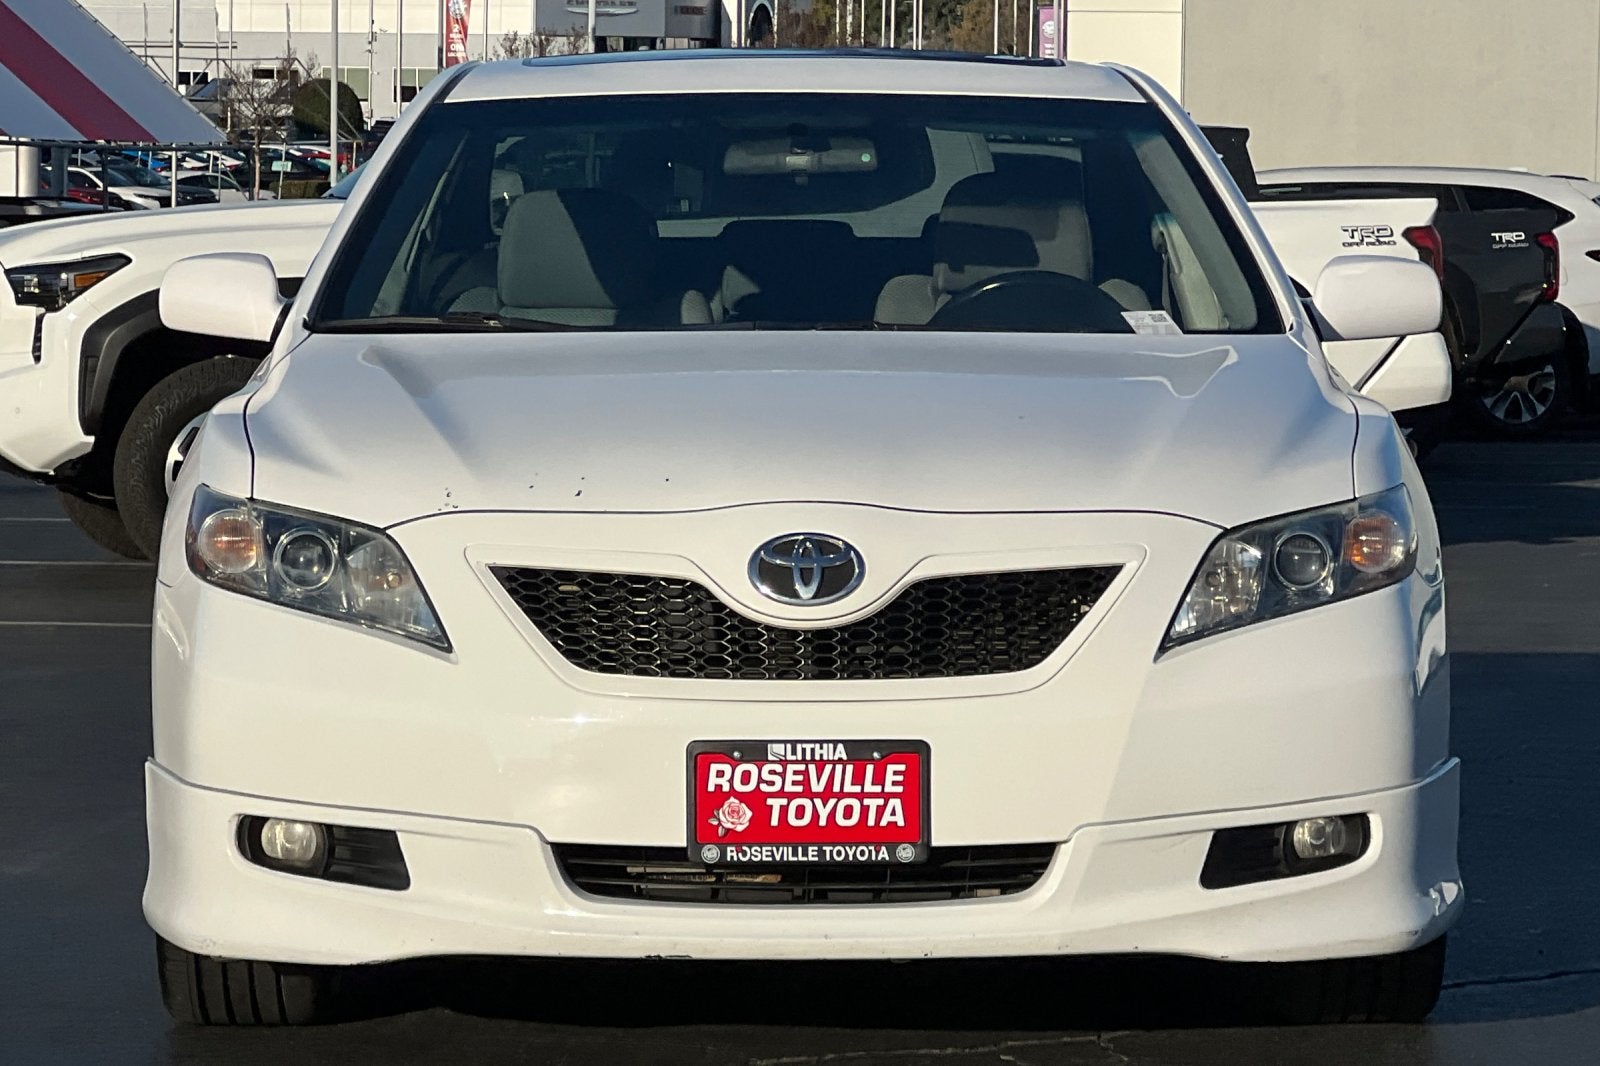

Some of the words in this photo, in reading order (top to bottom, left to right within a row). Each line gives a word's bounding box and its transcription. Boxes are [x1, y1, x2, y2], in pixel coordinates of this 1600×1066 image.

[1341, 225, 1394, 242] TRD
[1491, 231, 1525, 243] TRD
[785, 743, 847, 760] LITHIA
[707, 763, 906, 792] ROSEVILLE
[766, 798, 905, 827] TOYOTA
[726, 846, 818, 861] ROSEVILLE
[822, 846, 889, 861] TOYOTA
